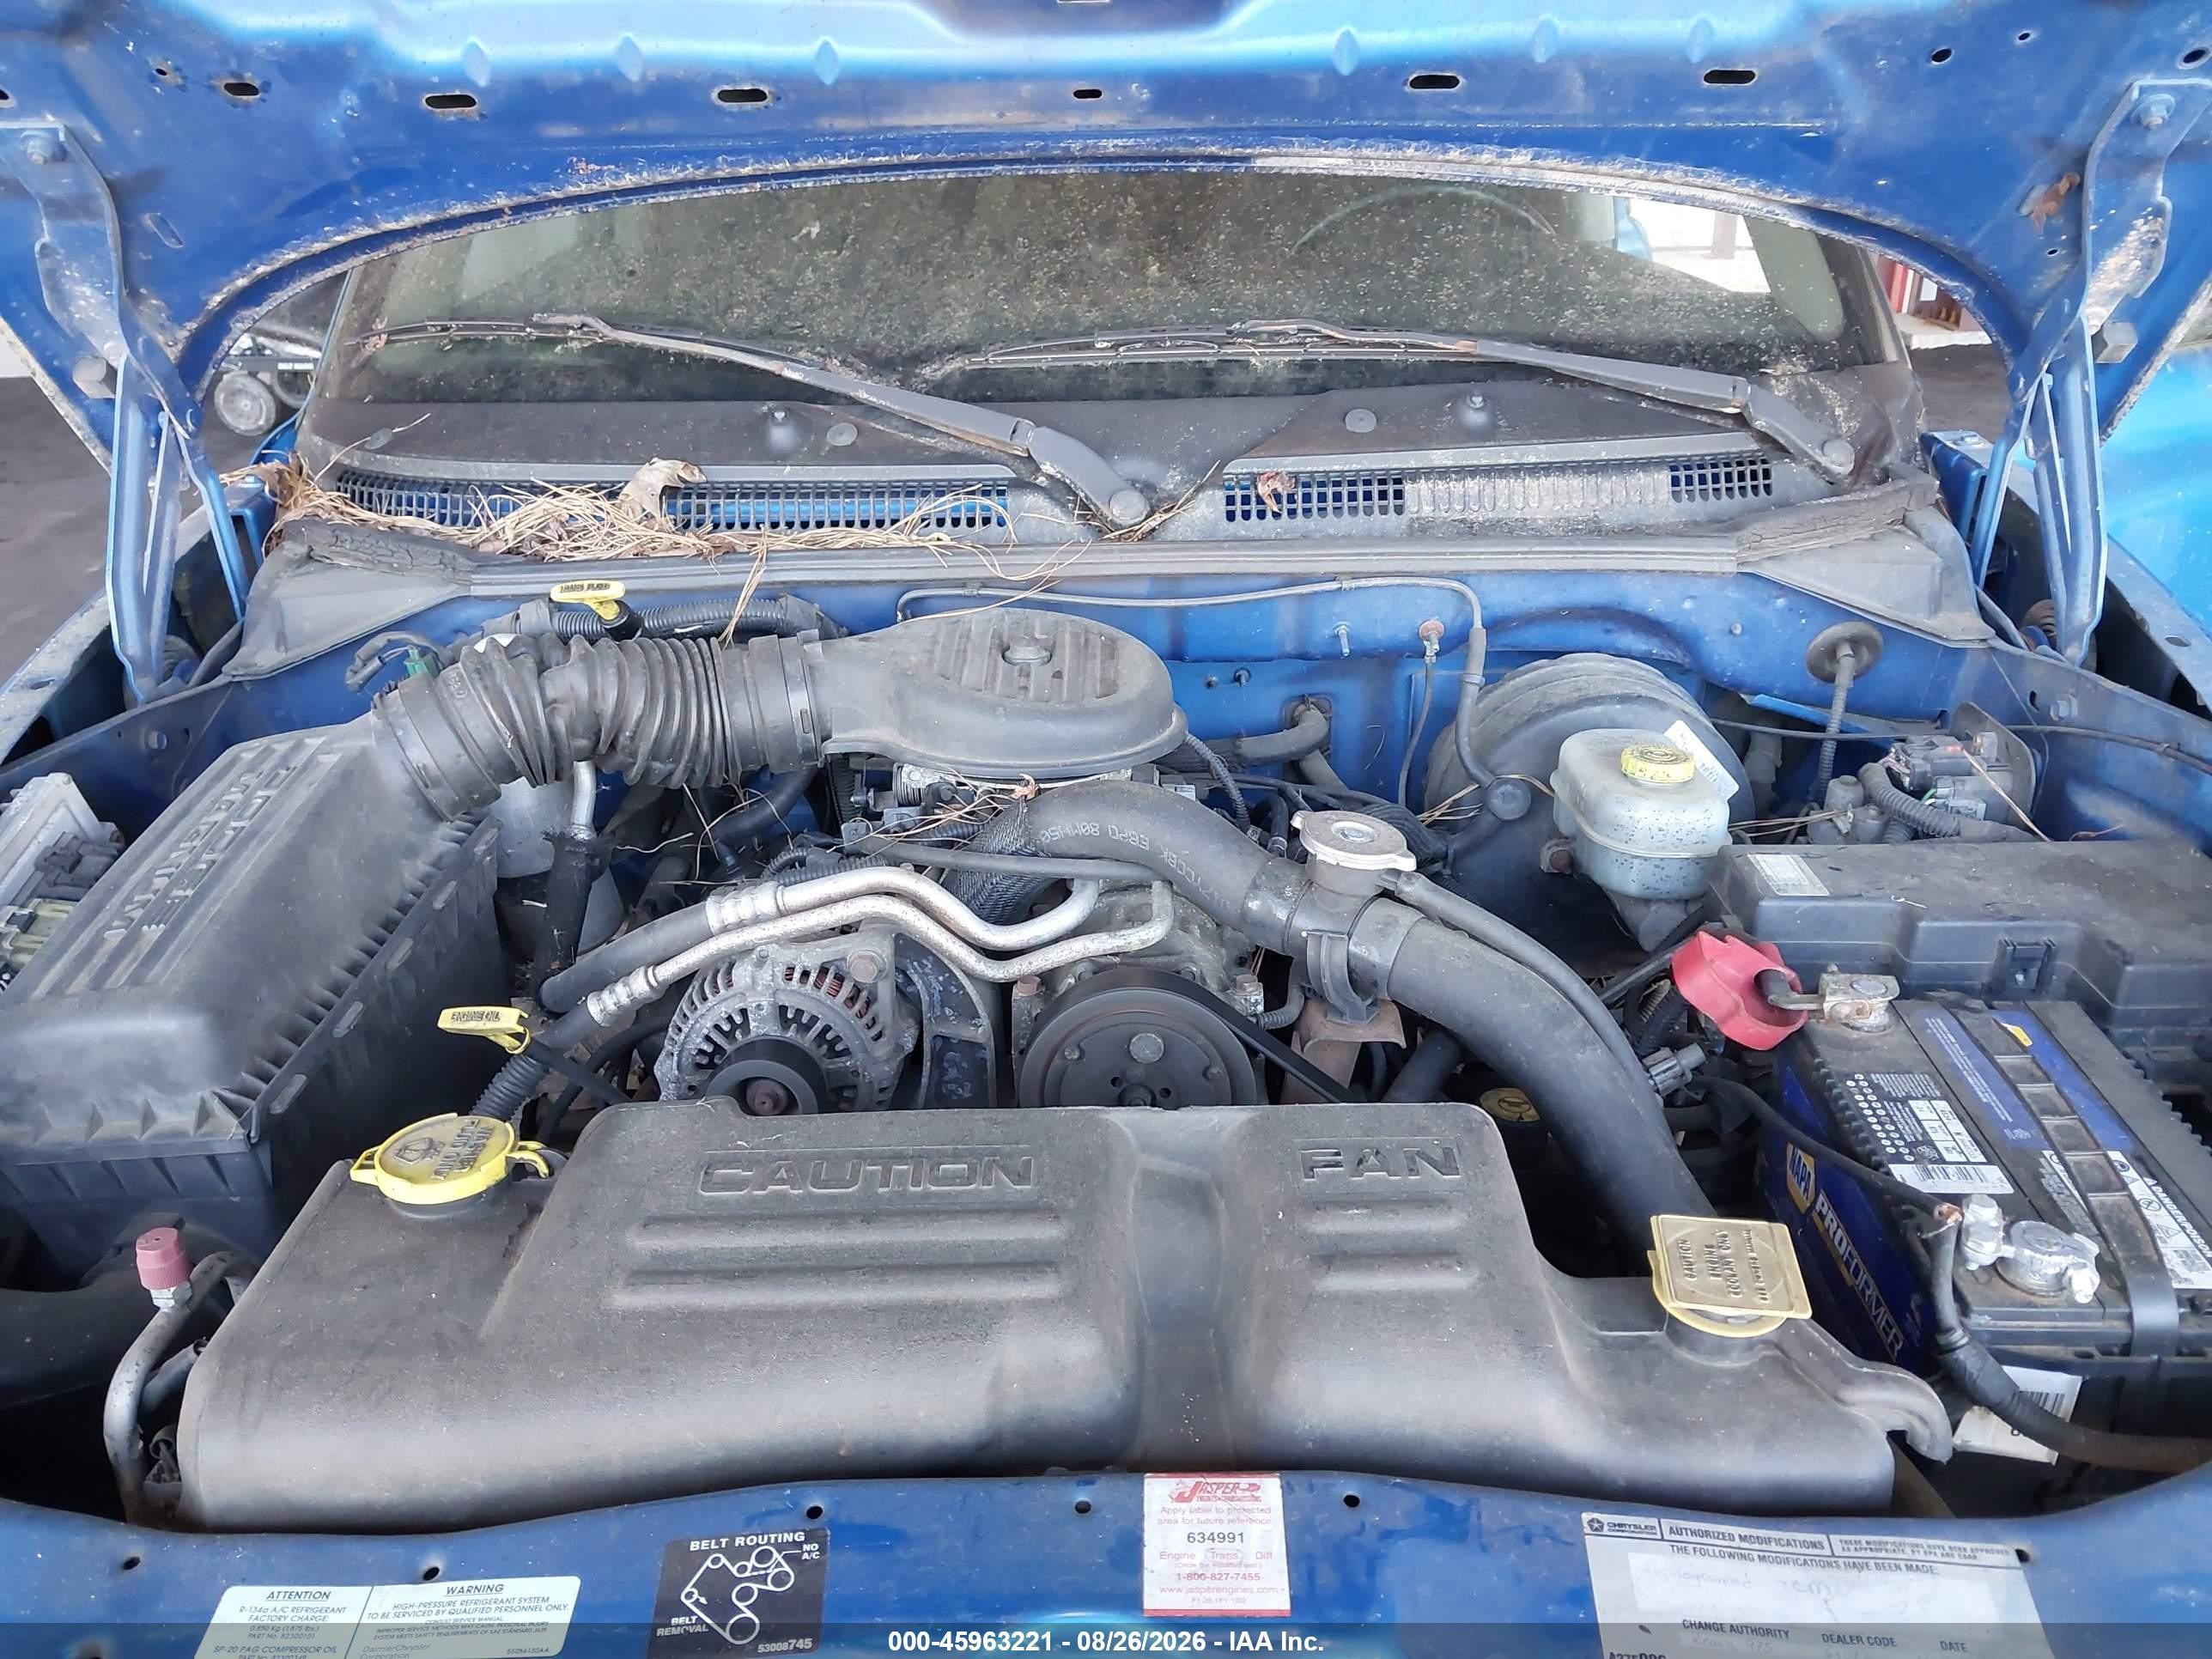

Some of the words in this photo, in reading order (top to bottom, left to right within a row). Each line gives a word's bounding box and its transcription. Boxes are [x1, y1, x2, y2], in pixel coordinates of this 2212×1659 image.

[486, 1011, 501, 1022] OIL
[699, 1157, 1033, 1194] CAUTION
[1299, 1147, 1461, 1182] FAN
[1790, 1146, 1812, 1200] NAPA
[1678, 1238, 1697, 1280] CAUTION
[1815, 1193, 1903, 1357] PROFORMER
[1161, 1507, 1186, 1516] Apply
[1607, 1521, 1656, 1531] CHRYSLER
[690, 1538, 729, 1552] BELT
[735, 1532, 805, 1547] ROUTING
[1187, 1532, 1244, 1543] 634991
[1668, 1525, 1735, 1542] AUTHORIZED
[1738, 1534, 1826, 1551] MODIFICATIONS
[801, 1552, 820, 1560] A/C
[1159, 1552, 1196, 1561] Engine
[1670, 1545, 1690, 1555] THE
[1692, 1547, 1755, 1562] FOLLOWING
[1757, 1554, 1842, 1570] MODIFICATIONS
[1844, 1561, 1872, 1573] HAVE
[1875, 1563, 1902, 1572] BEEN
[1176, 1573, 1261, 1582] 1-800-827-7455
[266, 1591, 332, 1600] ATTENTION
[446, 1584, 504, 1595] WARNING
[1160, 1586, 1279, 1595] www.jasperengines.com
[392, 1600, 459, 1610] HIGH-PRESSURE
[460, 1597, 516, 1607] REFRIGERANT
[392, 1610, 434, 1619] SERVICED
[448, 1607, 492, 1615] QUALIFIED
[494, 1604, 545, 1613] PERSONNEL
[671, 1615, 697, 1626] BELT
[656, 1624, 708, 1637] REMOVAL
[1682, 1620, 1727, 1633] CHANGE
[1729, 1624, 1790, 1640] AUTHORITY
[1821, 1633, 1864, 1645] DEALER
[1867, 1636, 1897, 1647] CODE
[1940, 1640, 1968, 1653] DATE
[362, 1643, 431, 1653] DaimlerChrysler
[757, 1638, 813, 1653] 53008745
